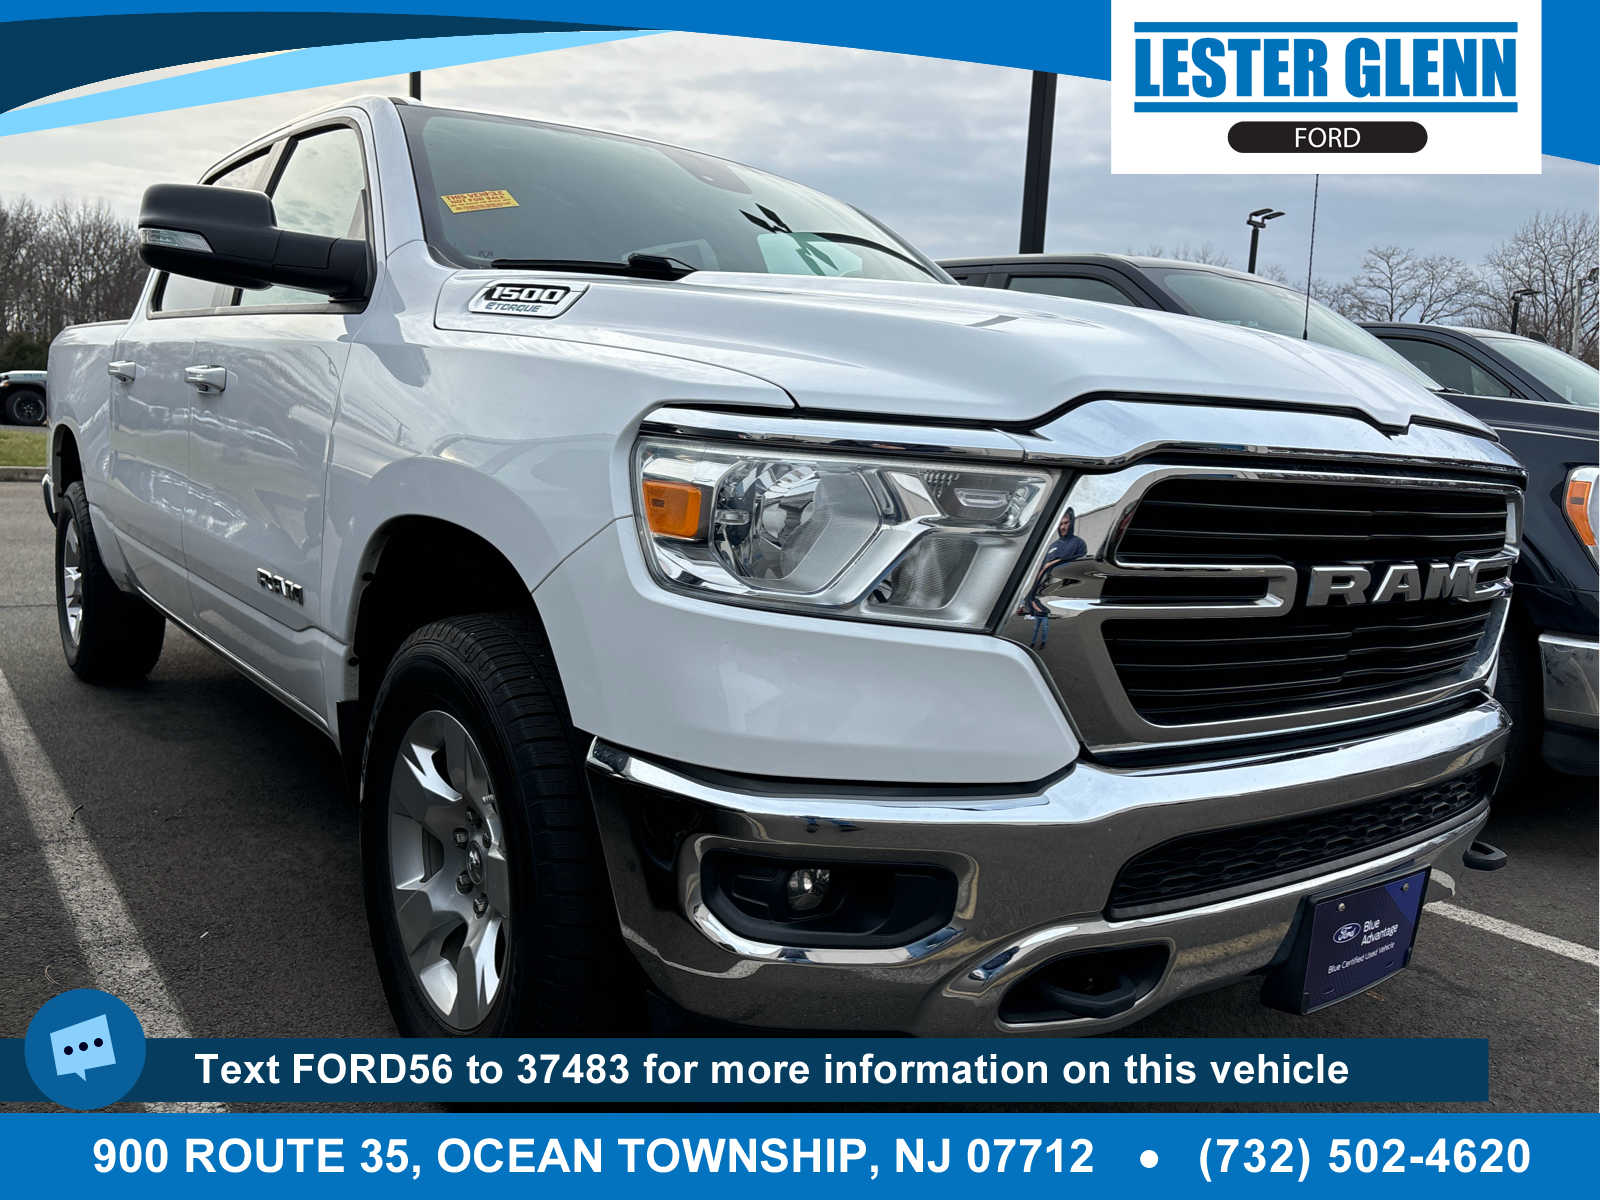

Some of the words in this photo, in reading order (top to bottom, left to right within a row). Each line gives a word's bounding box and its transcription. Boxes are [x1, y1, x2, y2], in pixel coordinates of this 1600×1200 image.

[487, 285, 567, 303] 1500
[256, 567, 304, 608] RAM
[1306, 563, 1472, 606] RAM
[1360, 923, 1399, 946] Advantage
[1363, 919, 1380, 932] Blue
[1327, 963, 1341, 974] Blue
